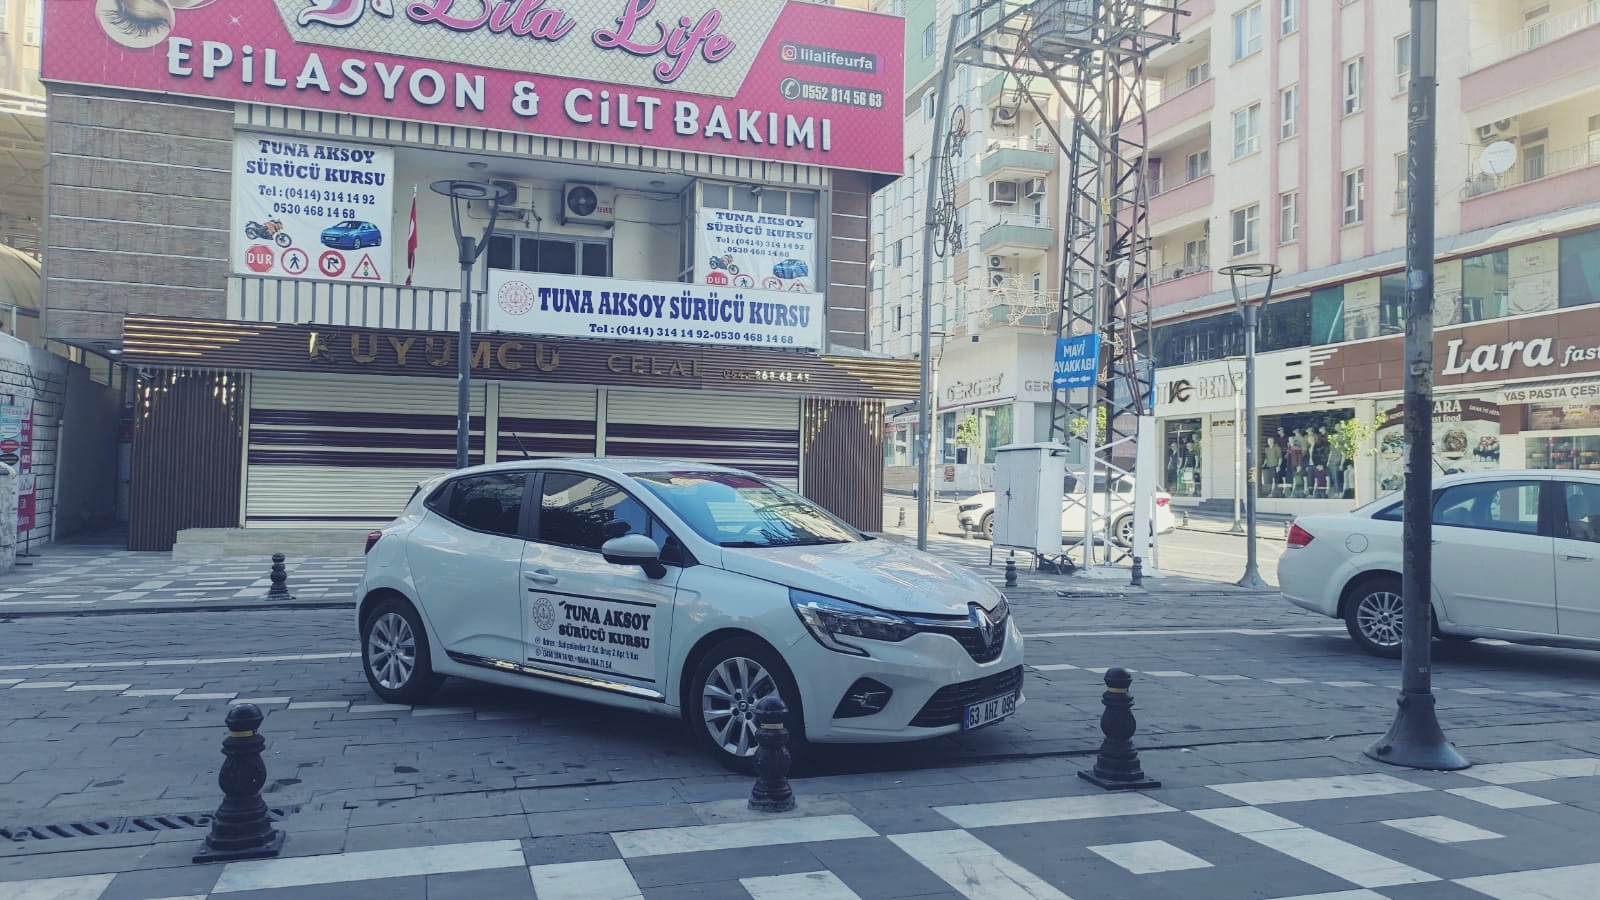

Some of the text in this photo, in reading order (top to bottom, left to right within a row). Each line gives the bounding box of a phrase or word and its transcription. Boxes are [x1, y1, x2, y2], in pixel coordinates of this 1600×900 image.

[592, 0, 736, 82] Life
[799, 47, 873, 71] lilalifeurfa
[802, 84, 882, 108] 0552 814 56 63
[511, 81, 540, 117] &
[673, 100, 832, 151] BAKIMI
[258, 139, 375, 164] TUNA AKSOY
[246, 158, 385, 186] SÜRÜCÜ KURSU
[258, 185, 276, 196] Tel
[285, 187, 321, 202] (0414)
[324, 190, 343, 202] 314
[347, 194, 359, 204] 14
[362, 195, 375, 205] 92
[273, 203, 355, 219] 0530 468 14 68
[716, 211, 804, 228] TUNA AKSOY
[706, 222, 813, 240] SÜRÜCÜ KURSU
[765, 241, 780, 249] 314
[247, 253, 272, 265] DUR
[707, 275, 727, 285] DUR
[538, 287, 810, 328] TUNA AKSOY SÜRÜCÜ KURSU
[589, 323, 608, 333] Tel
[616, 326, 654, 338] (0414)
[657, 328, 677, 337] 314
[680, 329, 693, 338] 14
[743, 332, 763, 343] 468
[766, 334, 778, 343] 14
[781, 335, 793, 344] 68
[309, 332, 560, 372] KUYUMCU
[1063, 339, 1086, 358] MAVİ
[1442, 338, 1600, 376] Lara fast
[1054, 357, 1096, 373] AYAKKABI
[1529, 388, 1567, 399] PASTA
[1432, 400, 1462, 413] ARA
[1443, 414, 1461, 422] food
[562, 603, 651, 631] TUNA AKSOY
[559, 623, 650, 649] SÜRÜCÜ KURSU
[969, 695, 1014, 726] 63 AHZ 095
